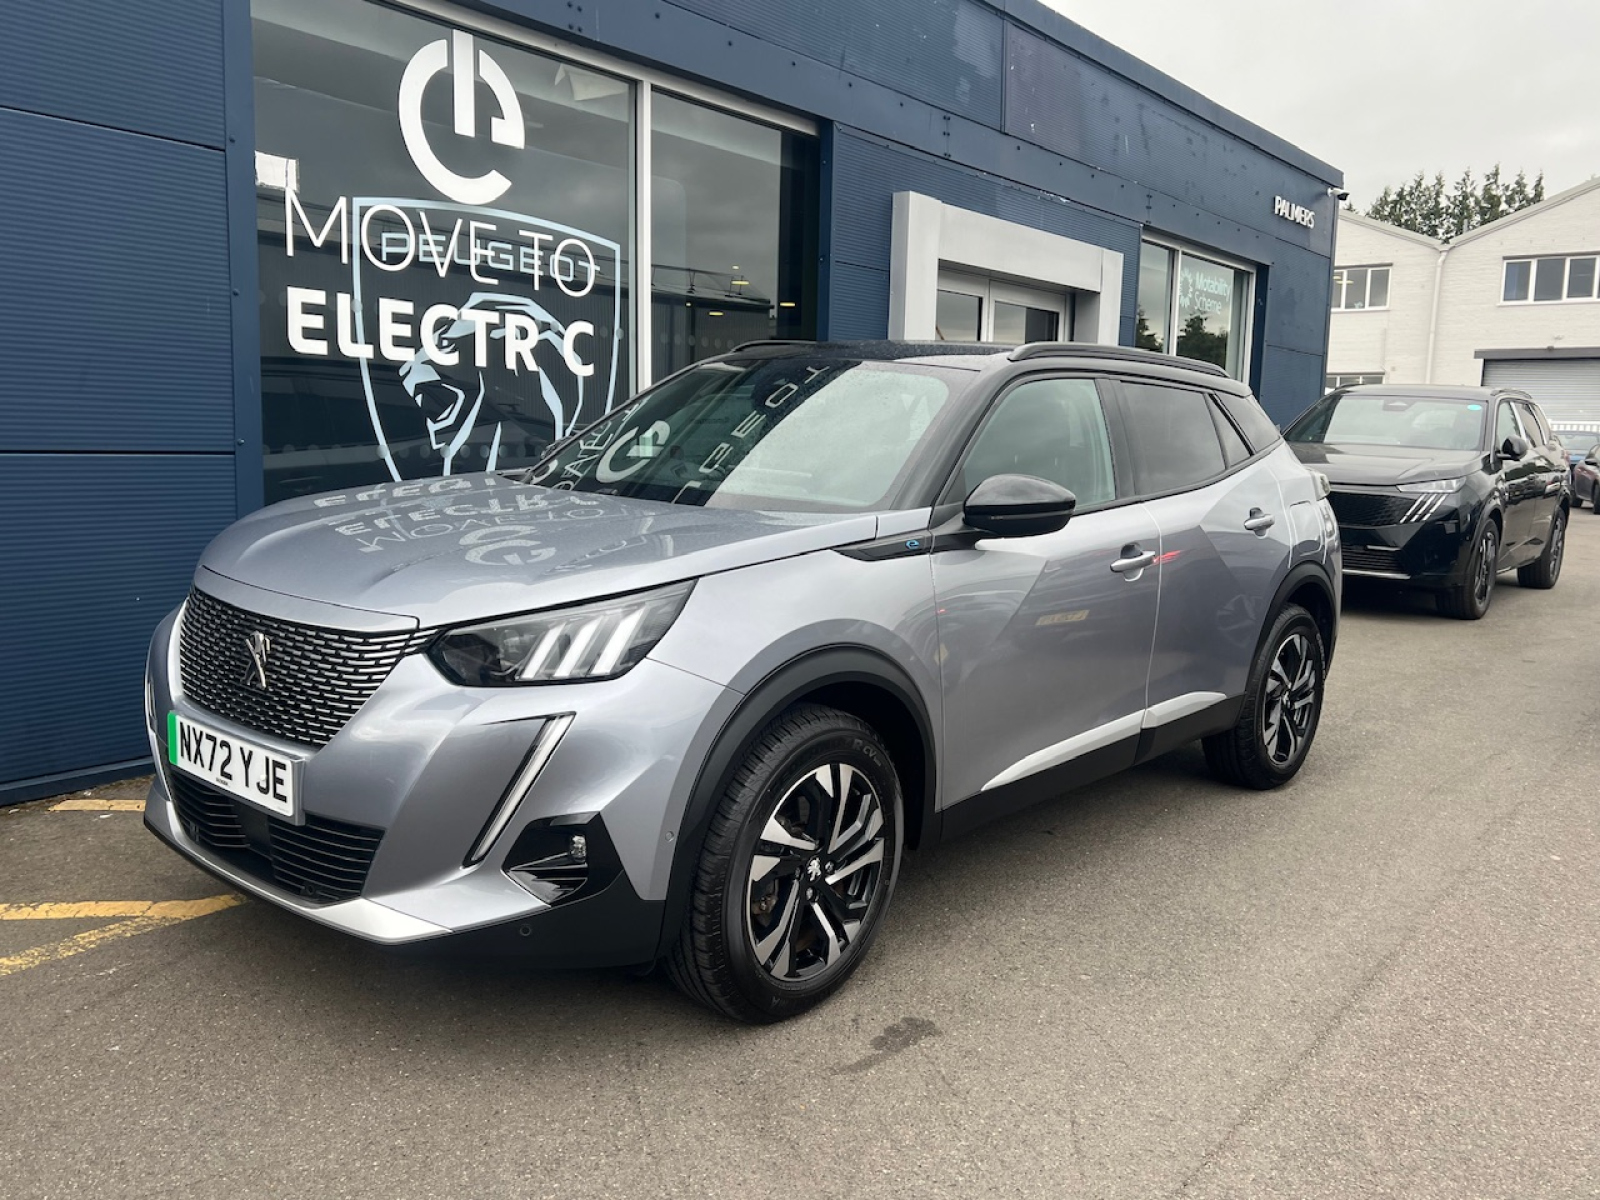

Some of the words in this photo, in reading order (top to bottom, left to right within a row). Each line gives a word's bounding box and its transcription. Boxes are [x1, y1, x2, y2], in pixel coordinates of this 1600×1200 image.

[285, 187, 499, 285] MOVE
[519, 230, 595, 297] TO
[1274, 195, 1315, 229] PALMERS
[381, 232, 600, 282] PEUGEOT
[287, 285, 595, 376] ELECTRC
[179, 721, 233, 781] NX72
[240, 746, 287, 803] YJE
